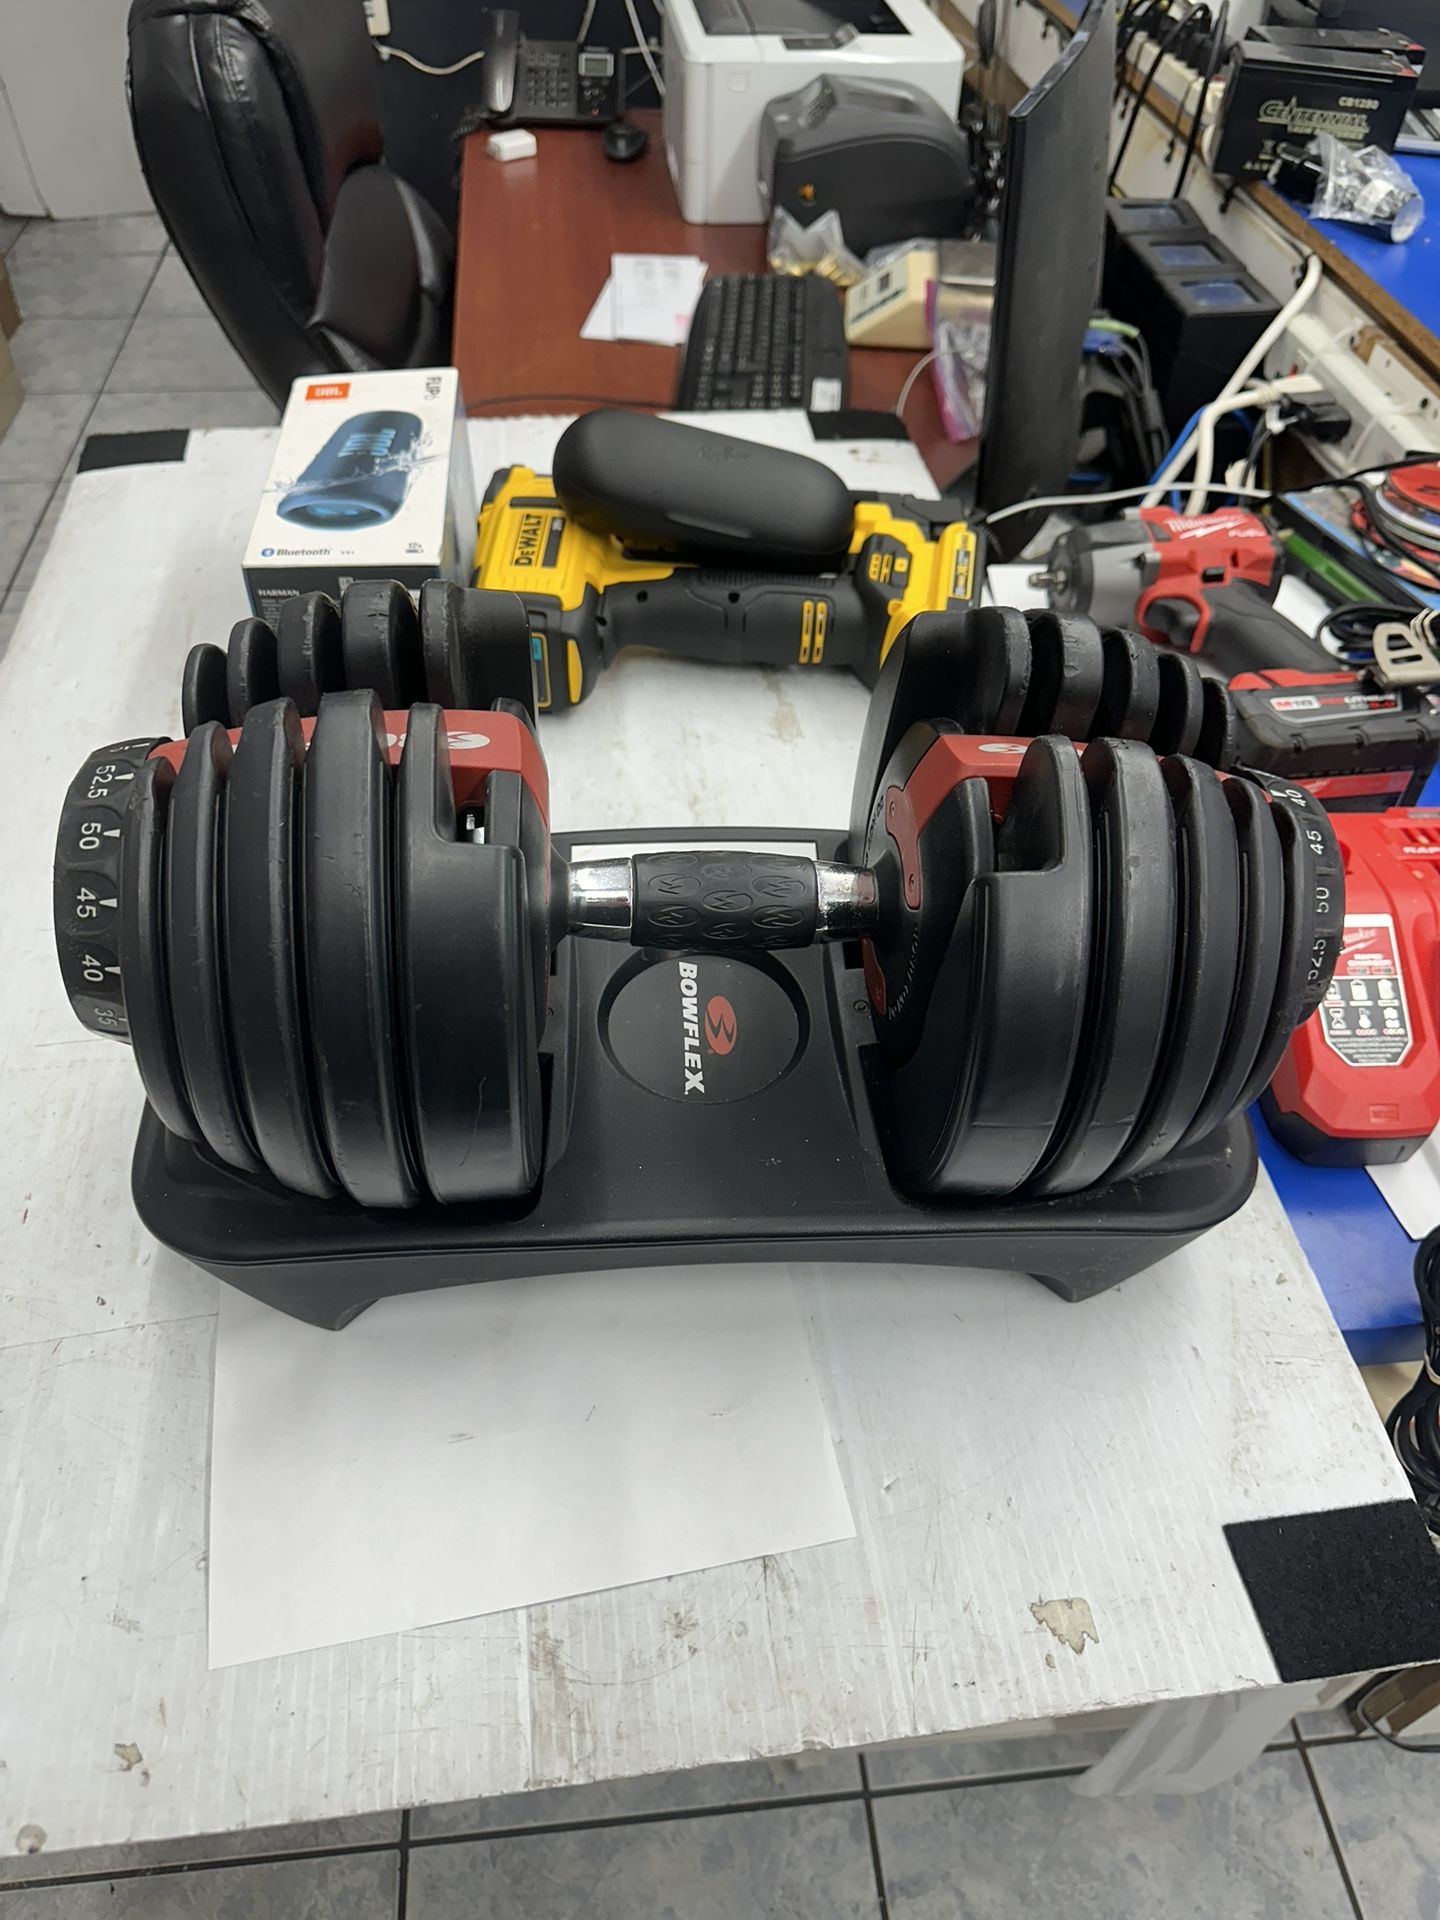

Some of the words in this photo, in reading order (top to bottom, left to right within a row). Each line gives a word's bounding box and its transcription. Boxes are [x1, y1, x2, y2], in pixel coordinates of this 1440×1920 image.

[276, 547, 331, 556] Bluetooth
[87, 764, 116, 799] 52.5
[1285, 780, 1306, 807] 40
[78, 821, 102, 850] 50
[1306, 829, 1324, 855] 45
[76, 887, 97, 918] 45
[1315, 887, 1330, 913] 50
[81, 954, 104, 982] 40
[678, 961, 705, 1095] BOWFLEX
